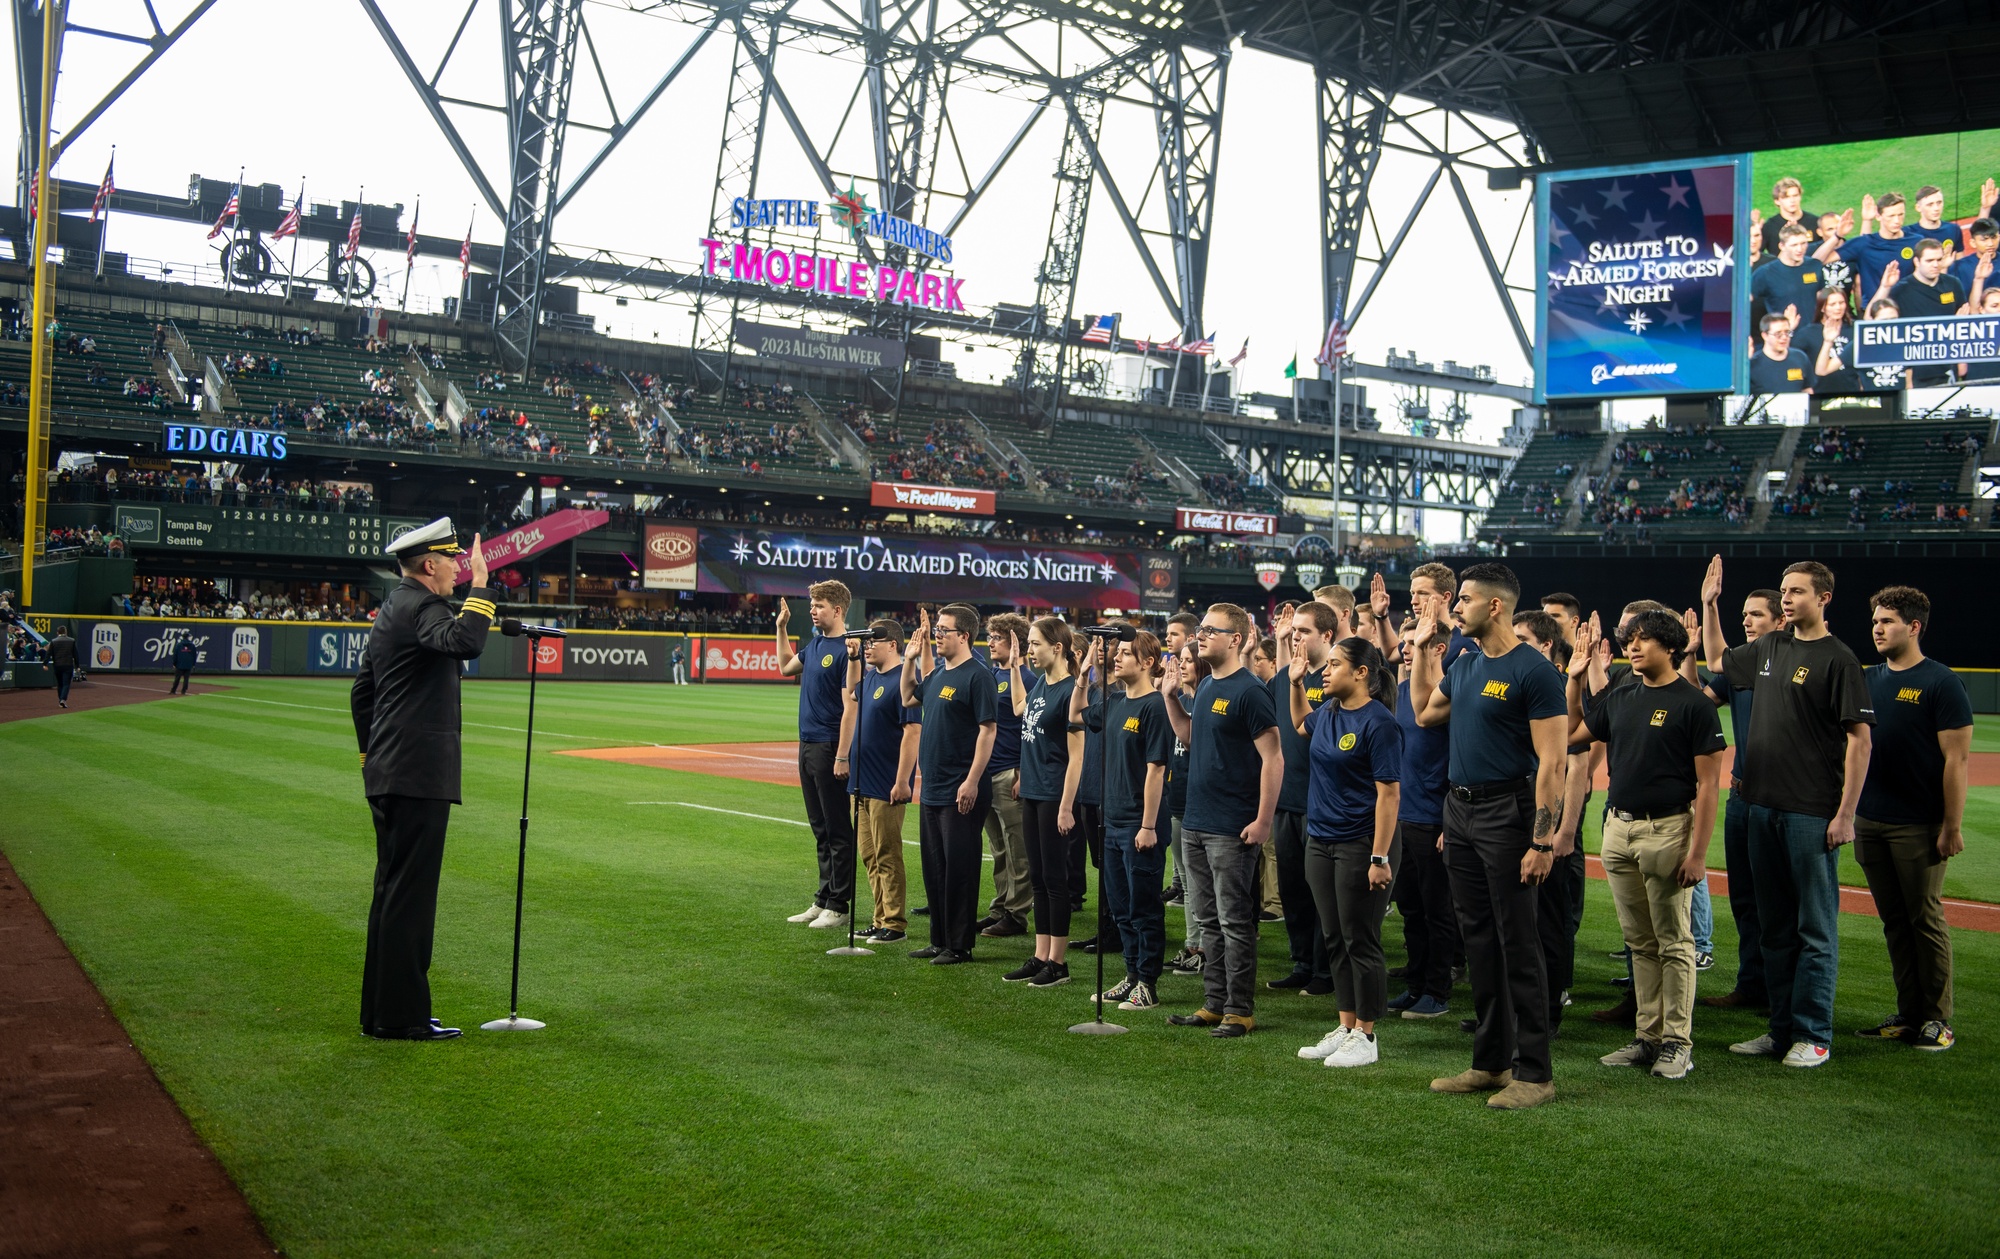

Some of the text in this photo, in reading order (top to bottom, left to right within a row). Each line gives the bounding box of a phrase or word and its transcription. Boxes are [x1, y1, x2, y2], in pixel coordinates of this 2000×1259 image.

[731, 197, 953, 264] SEATTLE MARINERS
[1589, 235, 1699, 263] SALUTE TO
[699, 238, 966, 311] T-MOBILE PARK
[1563, 259, 1719, 287] ARMED FORCES
[1604, 283, 1674, 306] NIGHT
[806, 331, 841, 344] HOME OF
[1863, 321, 1999, 345] ENLISTMENT
[761, 337, 790, 354] 2023
[848, 347, 881, 366] WEEK
[1904, 344, 1947, 360] UNITED
[1950, 341, 1995, 358] STATES
[167, 426, 287, 460] EDGAR'S
[234, 511, 240, 519] 2
[247, 512, 253, 520] 3
[260, 512, 266, 520] 4
[273, 513, 279, 521] 5
[285, 514, 291, 522] 6
[299, 515, 304, 523] 7
[311, 515, 317, 523] 8
[323, 516, 329, 524] 9
[350, 518, 356, 526] R
[362, 519, 368, 527] H
[374, 519, 380, 527] E
[166, 520, 380, 541] Tampa Bay 0 0 0
[166, 536, 379, 555] Seattle 0 0 0
[657, 539, 691, 556] EQC
[757, 540, 1095, 582] SALUTE TO ARMED FORCES NIGHT
[1148, 558, 1173, 569] Tito's
[1262, 572, 1276, 584] 42
[1304, 574, 1316, 585] 24
[34, 618, 51, 633] 331
[96, 629, 118, 645] Lite
[235, 633, 256, 647] Lite
[571, 648, 648, 666] TOYOTA
[730, 648, 779, 671] State
[1483, 681, 1509, 696] NAVY
[1897, 688, 1922, 700] NAVY
